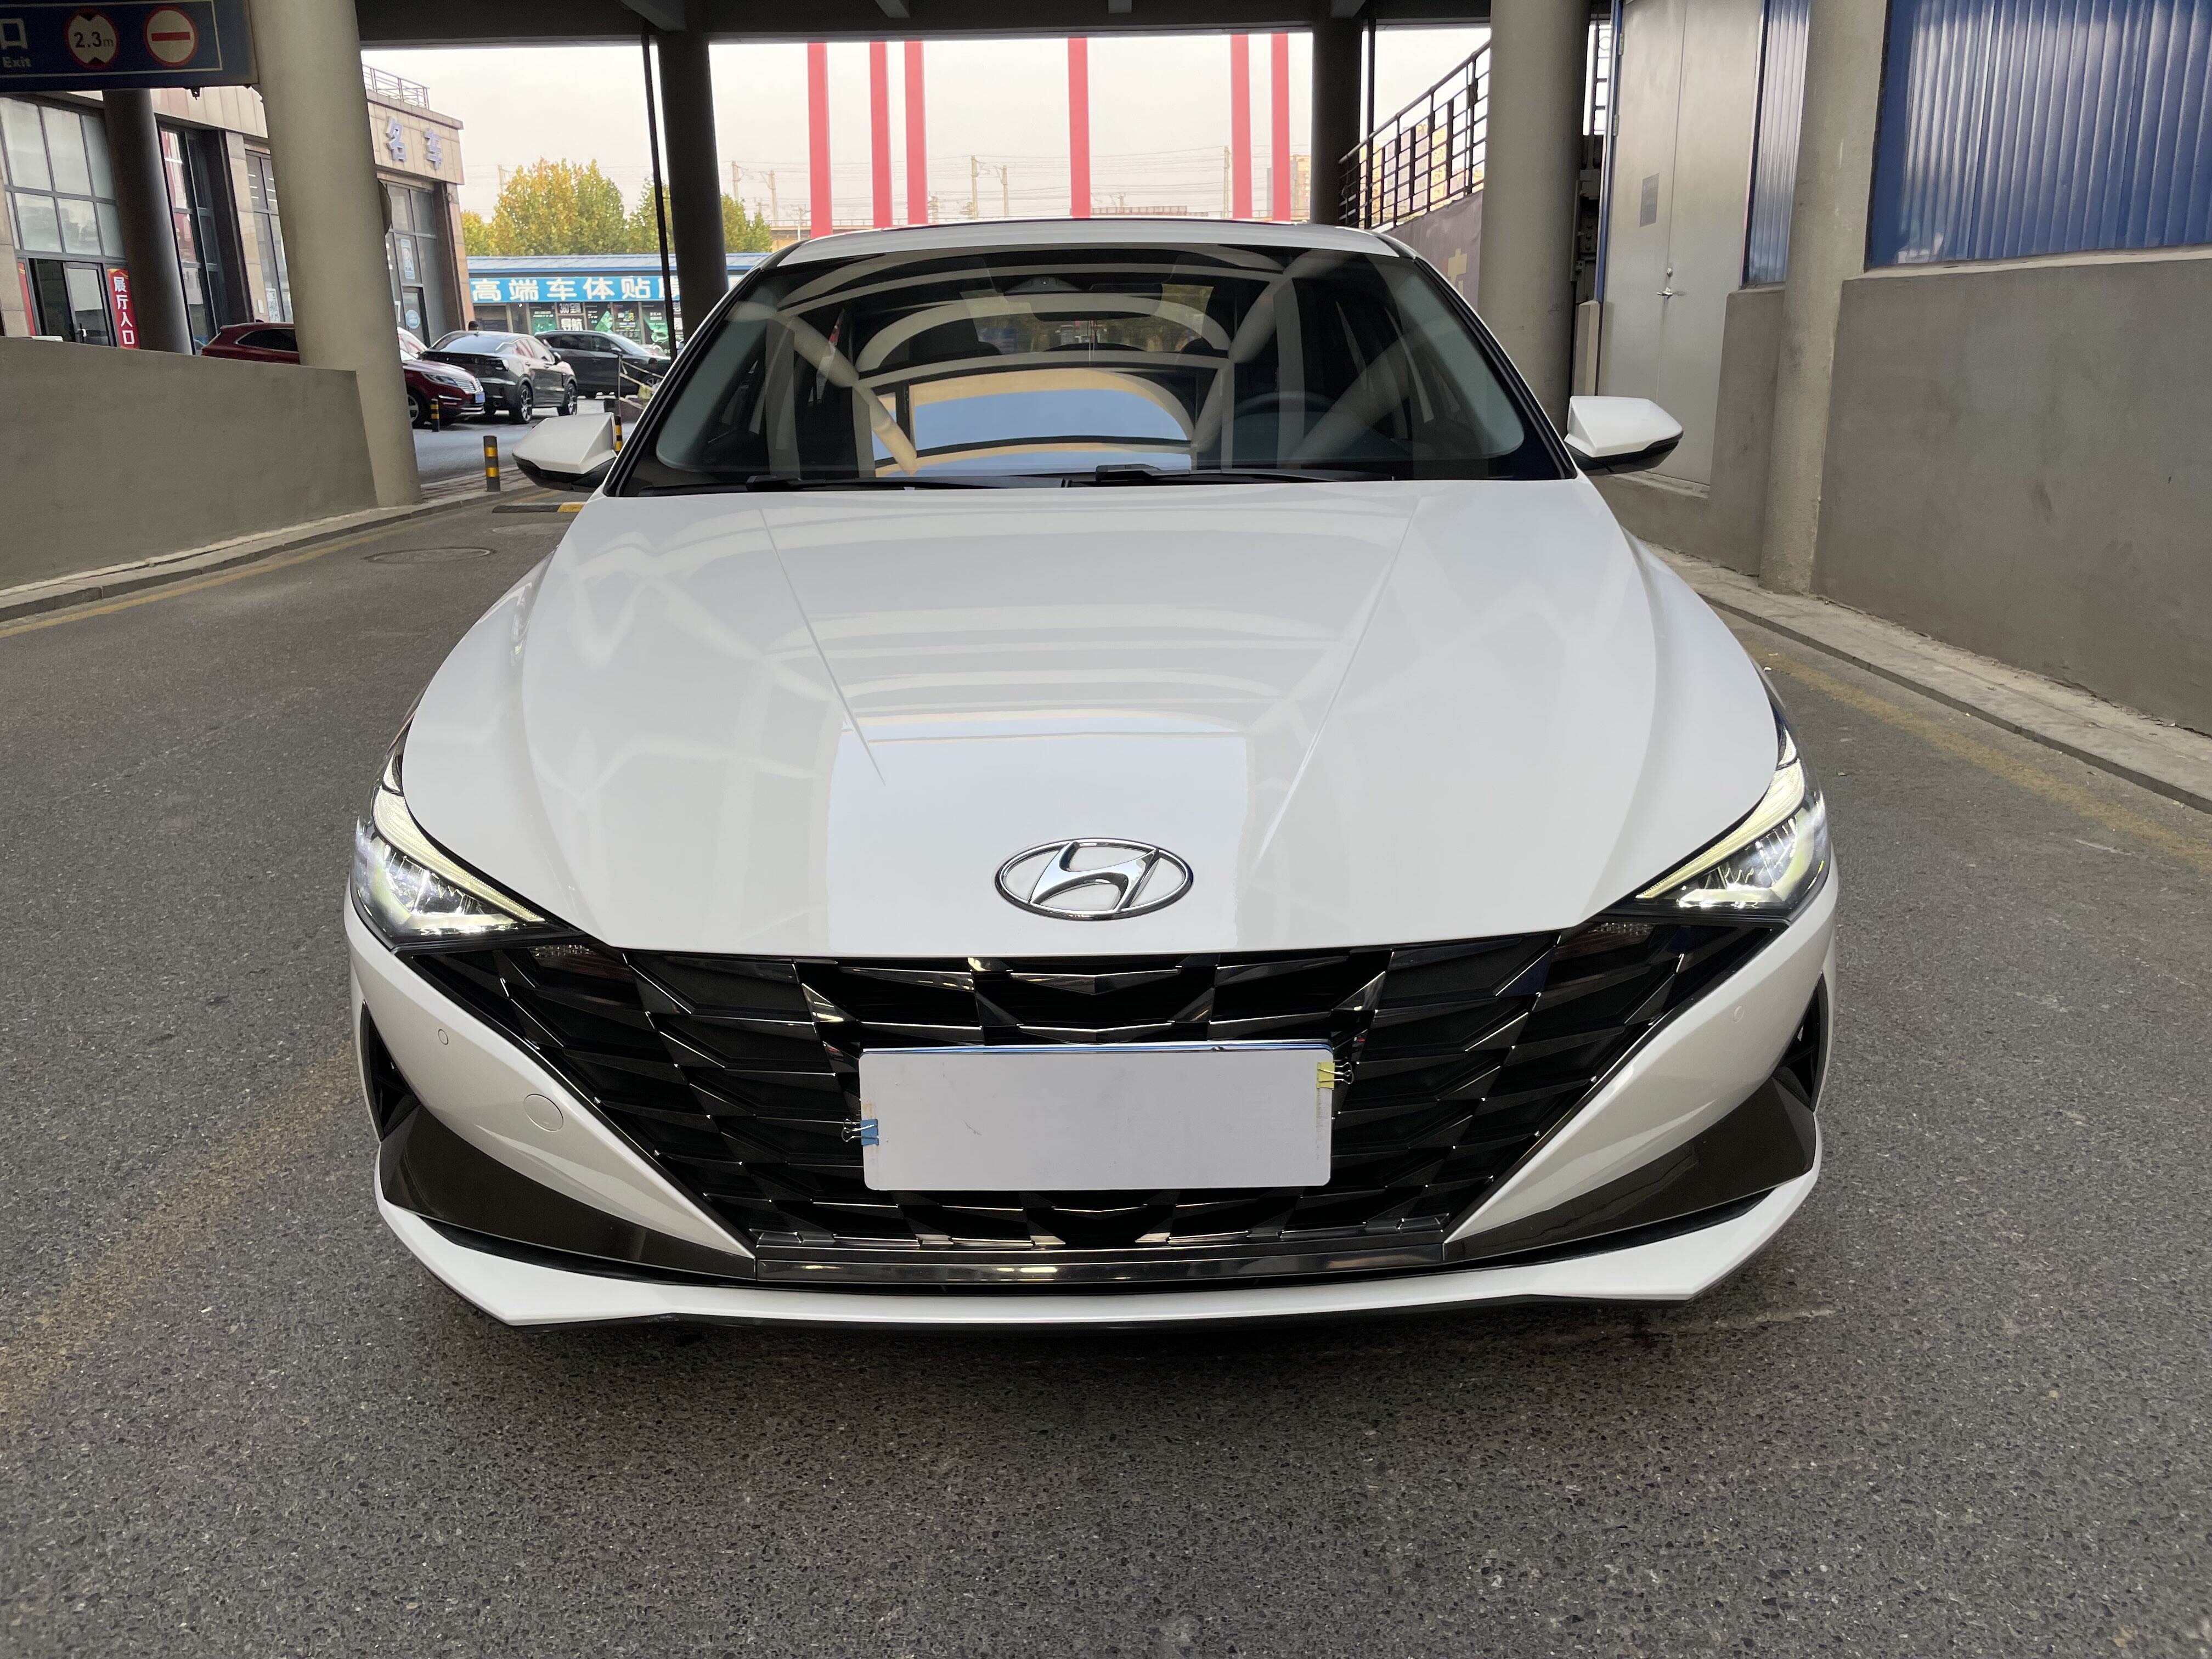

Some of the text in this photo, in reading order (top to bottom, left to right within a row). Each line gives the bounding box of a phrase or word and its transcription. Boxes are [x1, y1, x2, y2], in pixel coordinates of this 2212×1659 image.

[74, 31, 114, 48] 2.3m
[2, 57, 32, 67] Exit
[113, 276, 135, 345] 展厅入口
